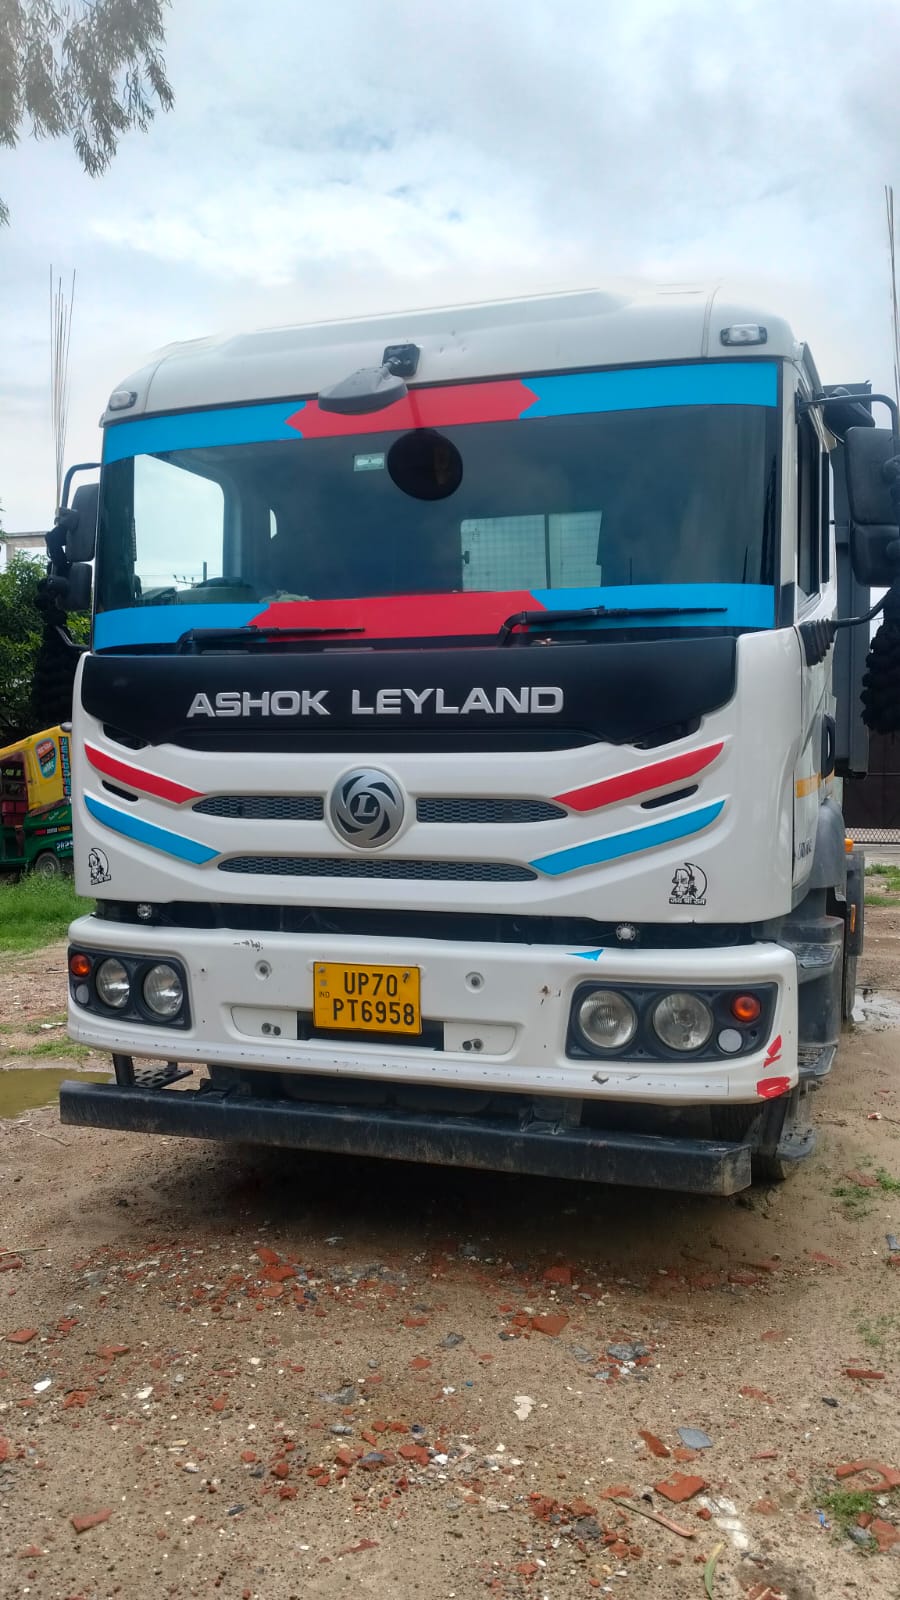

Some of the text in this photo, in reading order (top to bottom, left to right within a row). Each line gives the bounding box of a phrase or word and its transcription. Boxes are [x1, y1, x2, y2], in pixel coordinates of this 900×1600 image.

[186, 687, 564, 718] ASHOK LEYLAND
[354, 794, 378, 816] L
[343, 971, 398, 997] UP70
[332, 998, 415, 1026] PT6958
